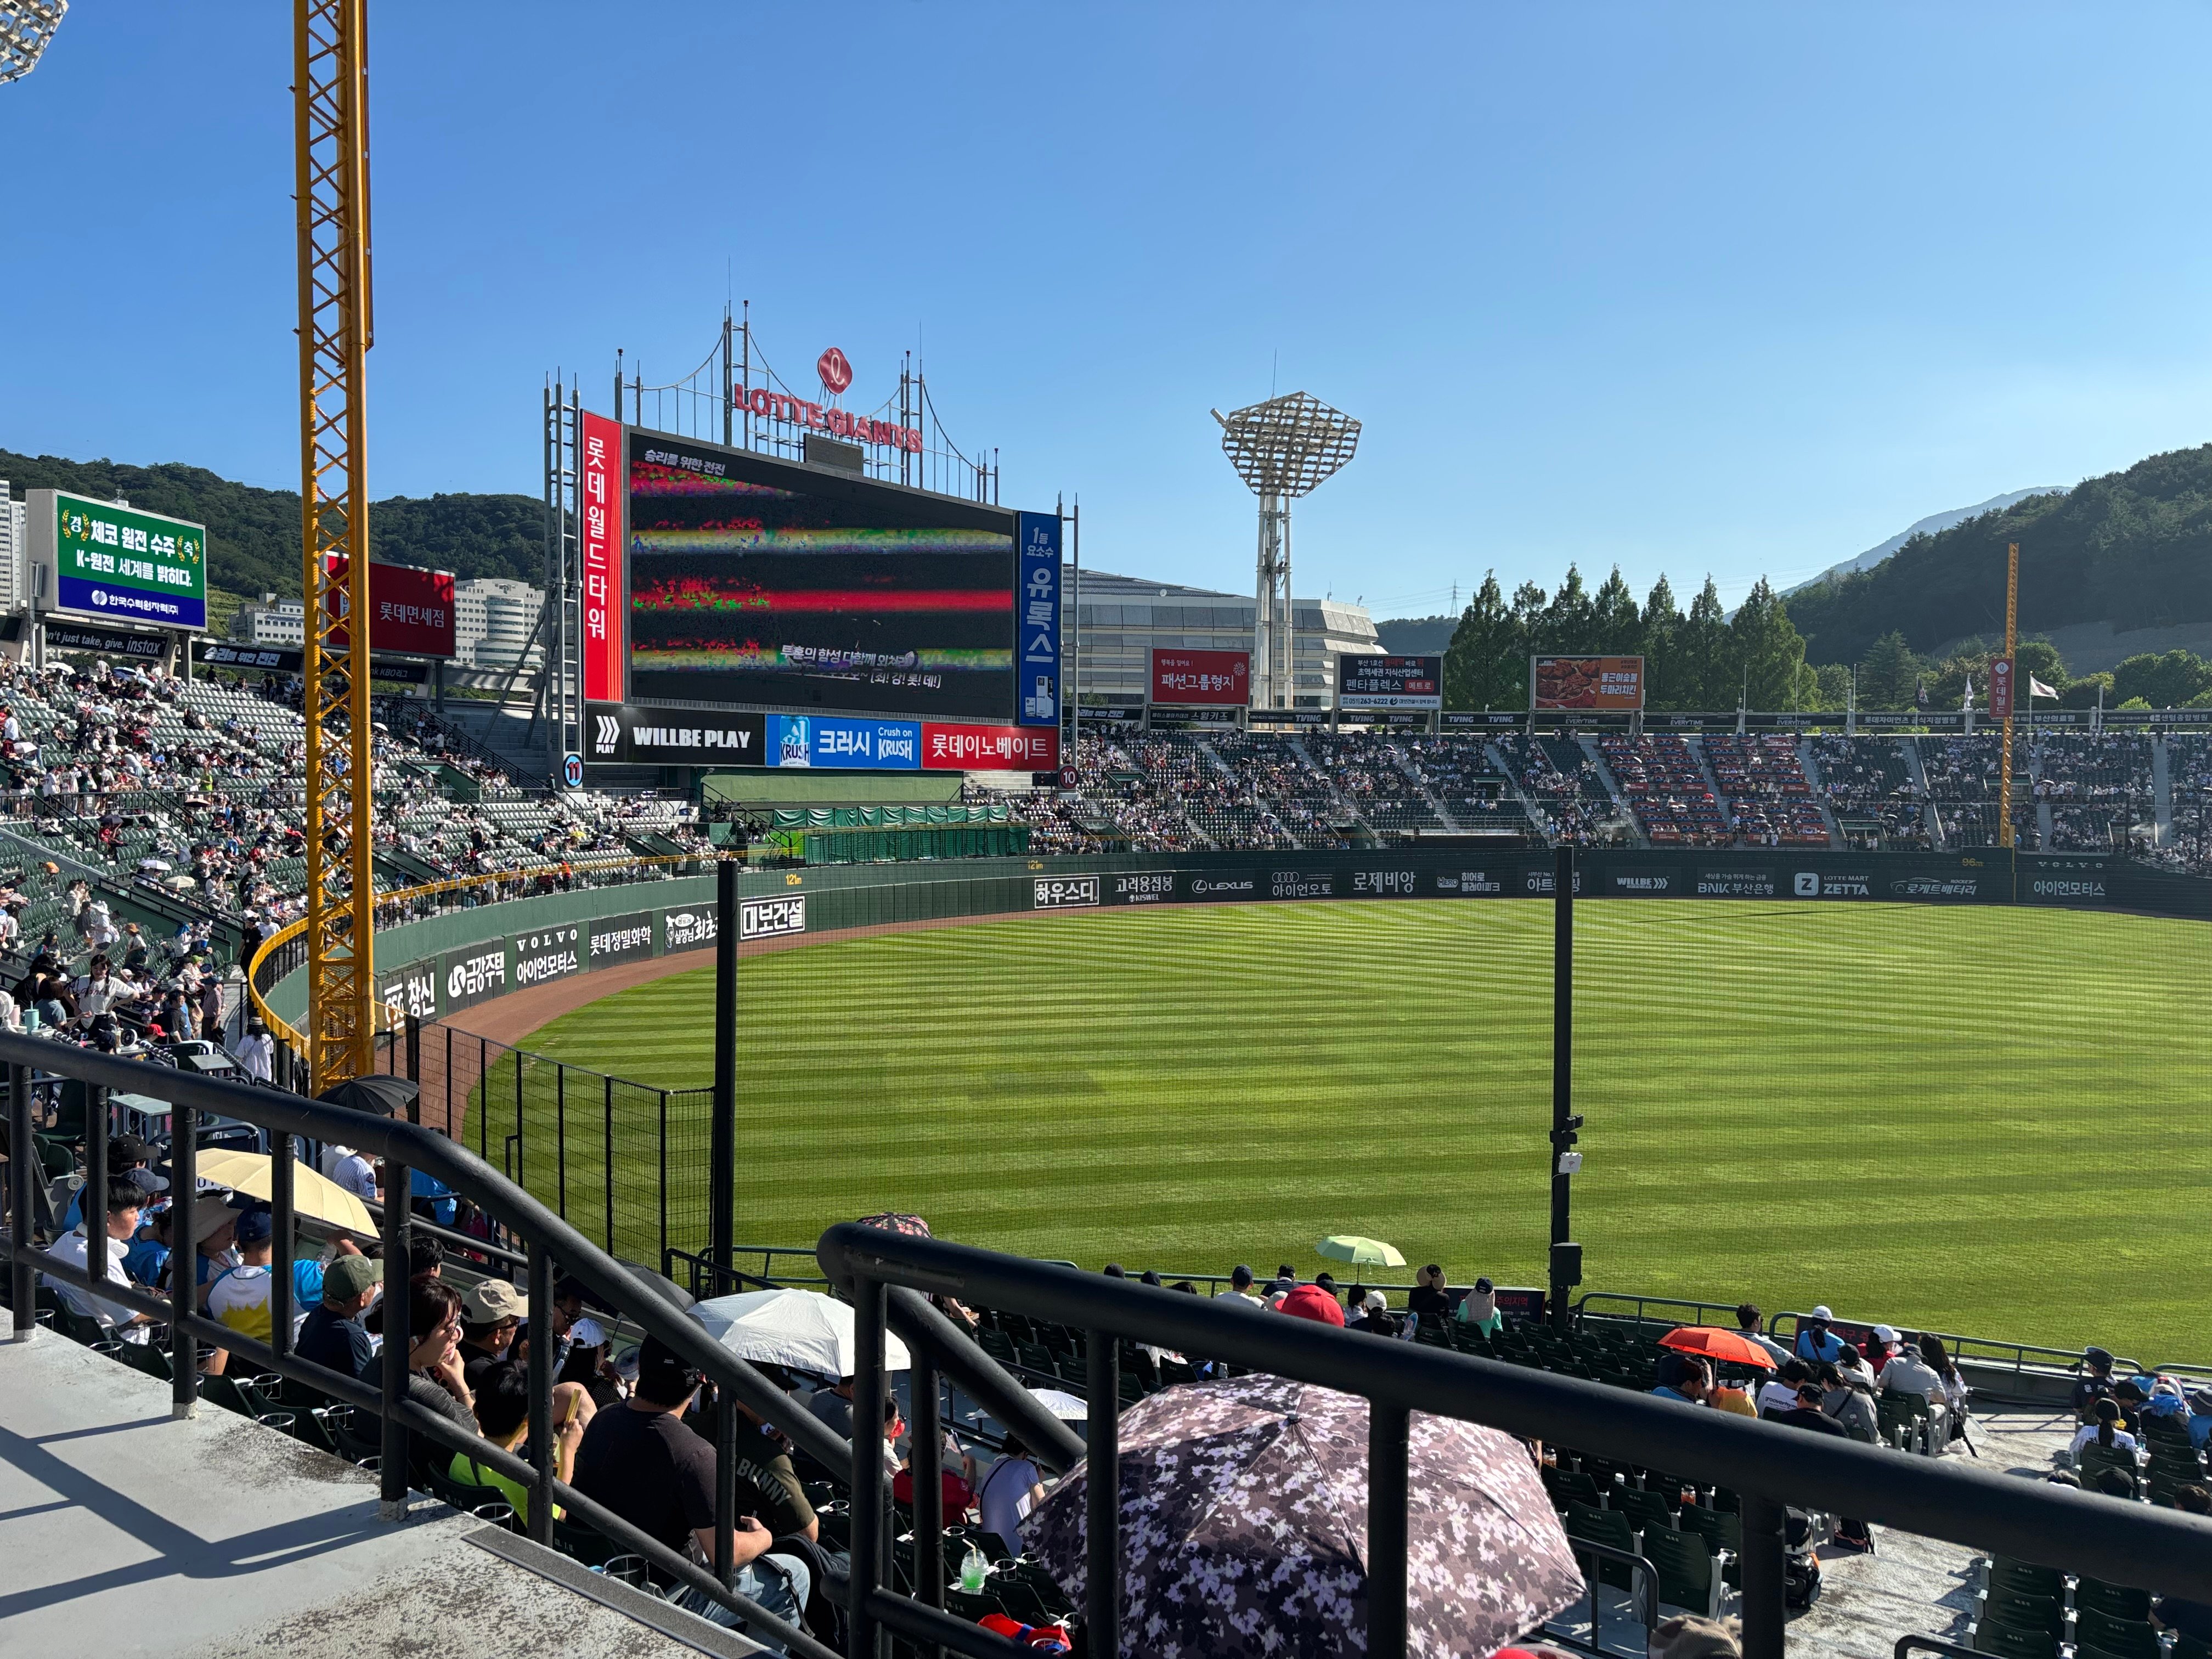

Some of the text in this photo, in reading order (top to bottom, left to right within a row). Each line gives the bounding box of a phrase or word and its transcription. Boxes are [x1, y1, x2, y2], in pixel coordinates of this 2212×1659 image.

[735, 383, 922, 453] LOTTE GIANTS
[645, 449, 726, 476] 승리를 위한 전진
[70, 516, 82, 533] 경
[91, 520, 194, 558] 체코 원전 수주 축
[588, 437, 607, 640] 롯데월드타워
[1033, 527, 1049, 545] 1등
[1026, 545, 1054, 558] 요소수
[76, 549, 115, 573] K-원전
[118, 557, 154, 581] 세계를
[380, 601, 444, 628] 롯데면세점
[1025, 568, 1054, 663] 유록스
[60, 632, 80, 644] just
[82, 635, 102, 648] take,
[105, 638, 124, 649] give.
[127, 636, 161, 654] instax
[819, 648, 841, 663] 함성
[1161, 673, 1234, 691] 패션그룹형지
[1346, 679, 1431, 691] 펜타플렉스 메트로
[1996, 676, 2006, 714] 롯데월드
[1350, 715, 1375, 723] TVING
[1389, 715, 1414, 723] TVING
[1448, 715, 1474, 723] TVING
[633, 727, 751, 748] WILLBE PLAY
[878, 727, 900, 737] Crush
[596, 744, 615, 754] PLAY
[780, 742, 809, 763] KRUSH
[818, 730, 870, 757] 크러시
[878, 738, 912, 761] KRUSH
[932, 734, 1048, 760] 롯데이노베이트
[568, 761, 580, 781] 11
[1063, 771, 1076, 783] 10
[1027, 860, 1043, 870] 121m
[786, 873, 802, 885] 121m
[1115, 876, 1173, 893] 고려용접봉
[1209, 881, 1254, 890] LEXUS
[1353, 871, 1416, 893] 로제비앙
[1438, 877, 1458, 887] HERO
[1462, 872, 1485, 882] 히어로
[1462, 882, 1500, 891] 플레이파크
[1036, 881, 1093, 904] 하우스디
[1272, 883, 1333, 898] 아이언오토
[1698, 883, 1774, 894] BNK 부산은행
[1824, 883, 1870, 895] ZETTA
[1906, 883, 1977, 895] 로케트배터리
[2034, 881, 2106, 896] 아이언모터스
[743, 900, 803, 934] 대보건설
[674, 910, 718, 945] 실장님 회초
[517, 929, 577, 952] VOLVO
[590, 926, 651, 956] 롯데정밀화학
[466, 951, 505, 995] 금강주택
[517, 950, 577, 984] 아이언모터스
[408, 972, 435, 1017] 창신
[736, 1458, 792, 1506] BUNNY
